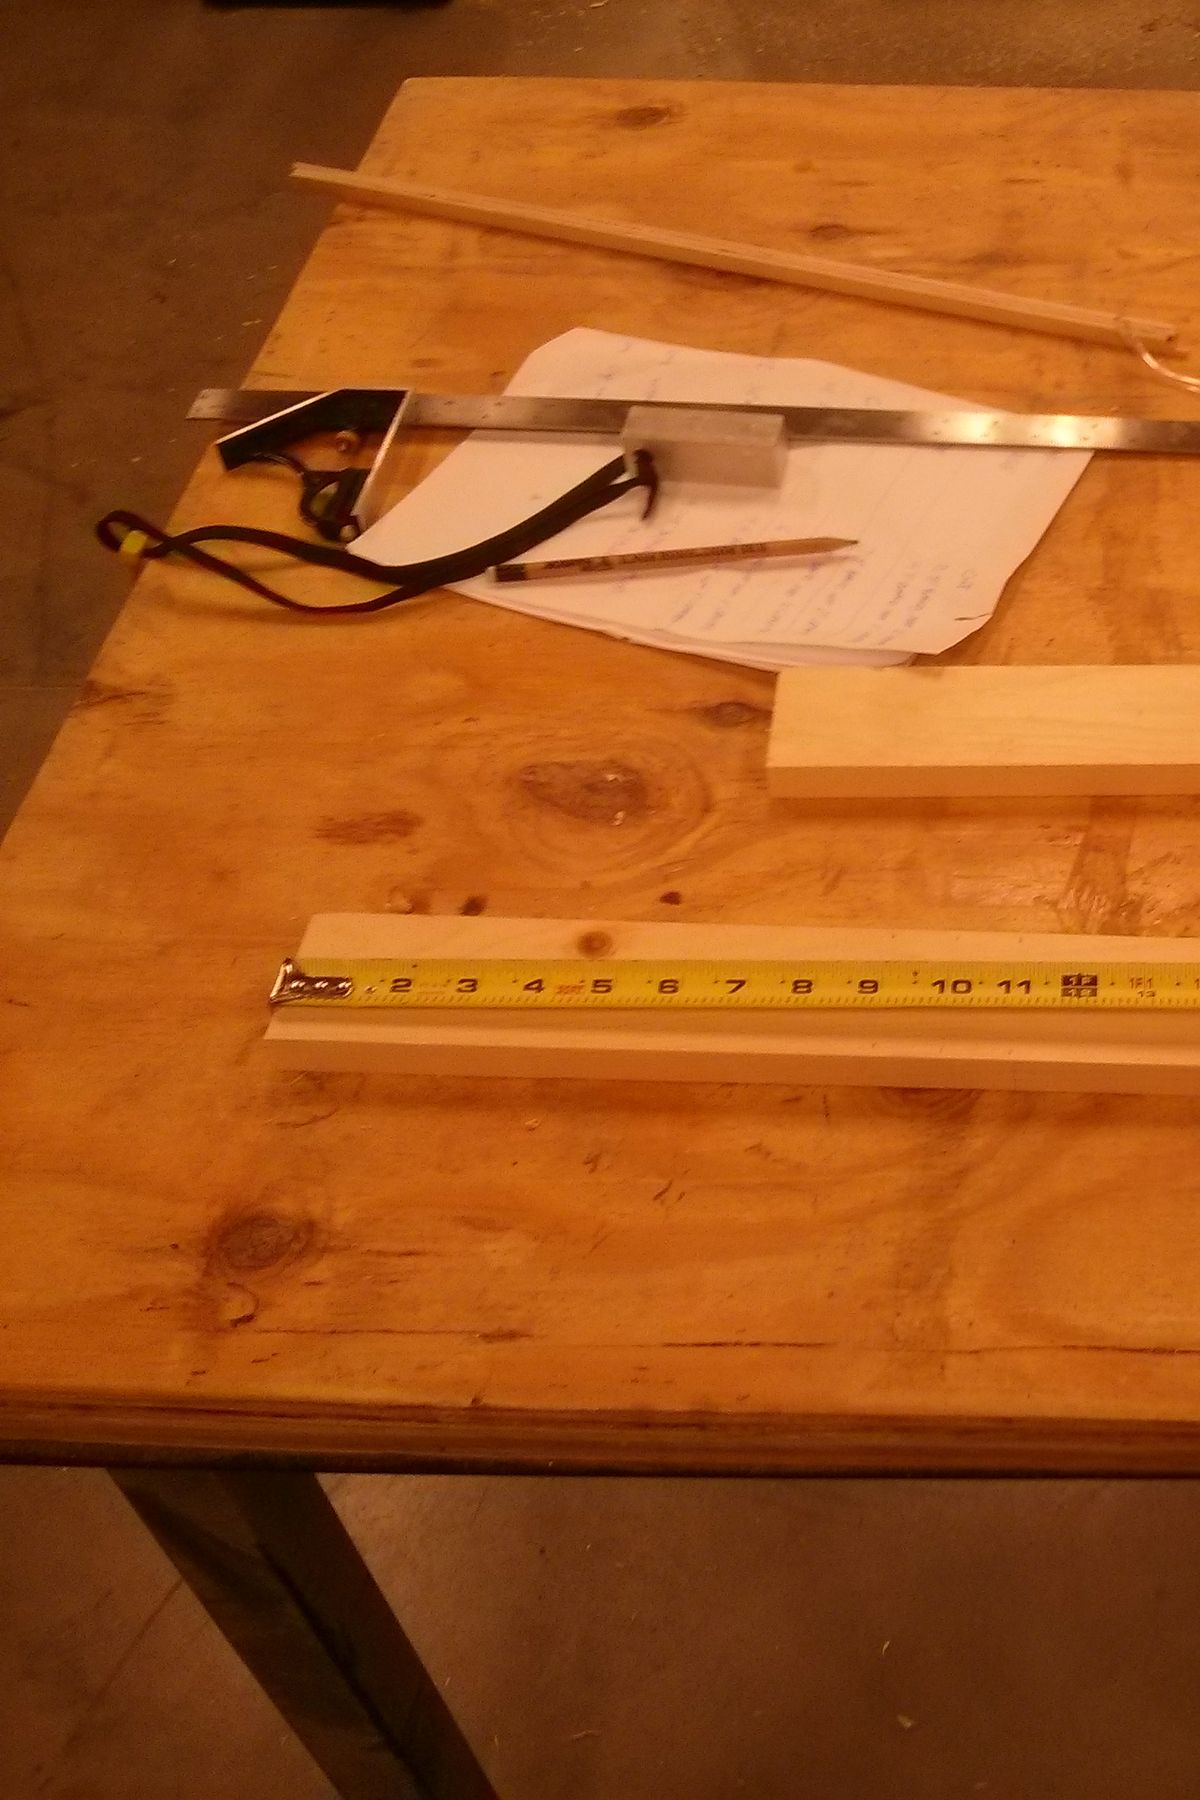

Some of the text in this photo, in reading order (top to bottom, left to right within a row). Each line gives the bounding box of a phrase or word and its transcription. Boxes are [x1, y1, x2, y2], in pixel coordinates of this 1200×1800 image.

[389, 977, 413, 993] 2
[456, 978, 479, 993] 3
[522, 978, 545, 993] 4
[590, 979, 613, 994] 5
[658, 979, 680, 994] 6
[725, 979, 747, 994] 7
[791, 979, 814, 994] 8
[857, 979, 880, 994] 9
[931, 979, 973, 994] 10
[997, 979, 1032, 994] 11
